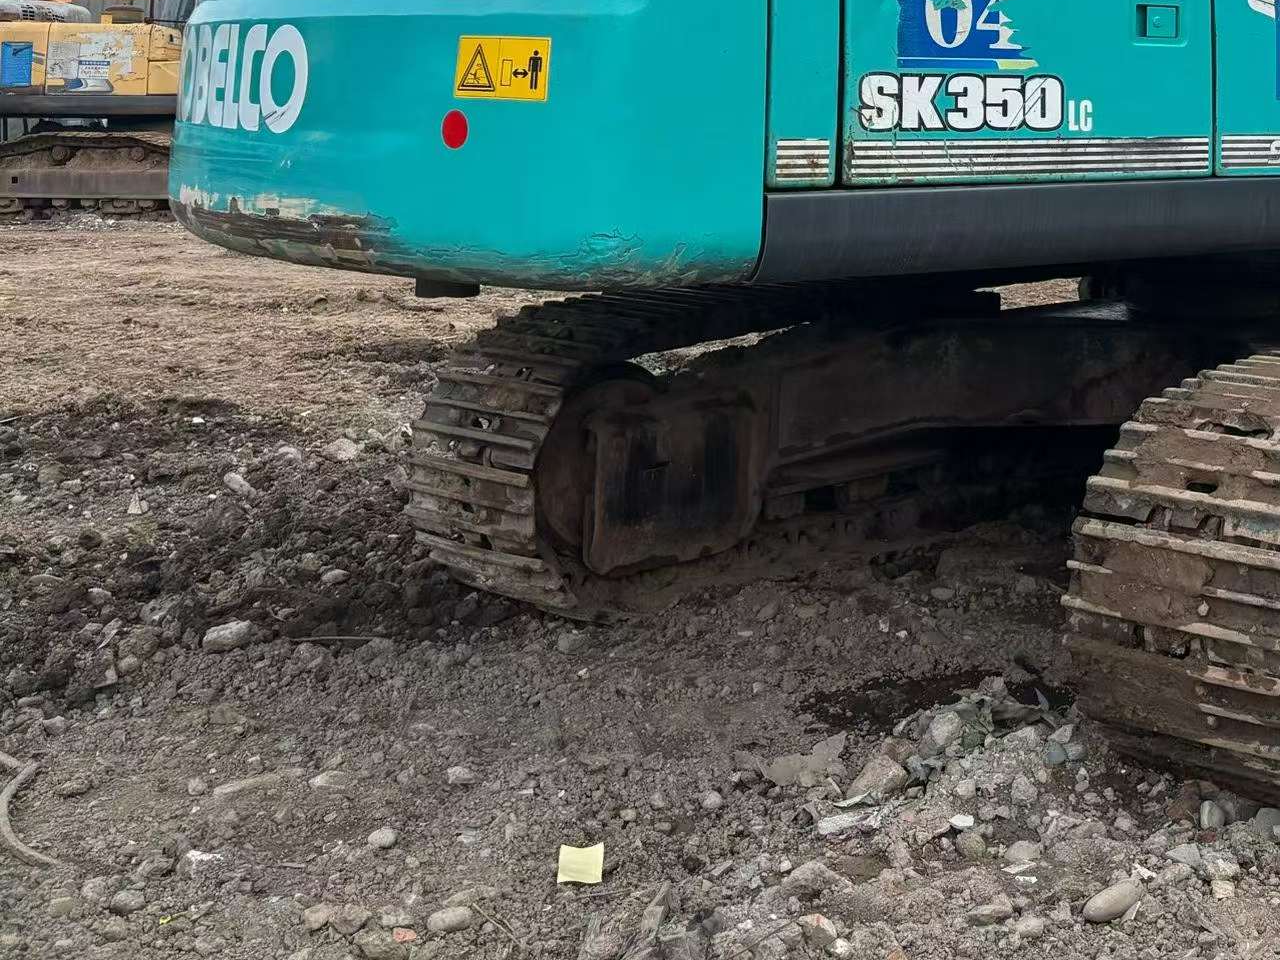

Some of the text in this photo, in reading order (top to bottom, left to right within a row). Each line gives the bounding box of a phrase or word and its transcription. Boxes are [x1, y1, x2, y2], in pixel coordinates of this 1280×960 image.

[177, 23, 308, 134] OBELCO
[860, 73, 1093, 132] SK350 LC
